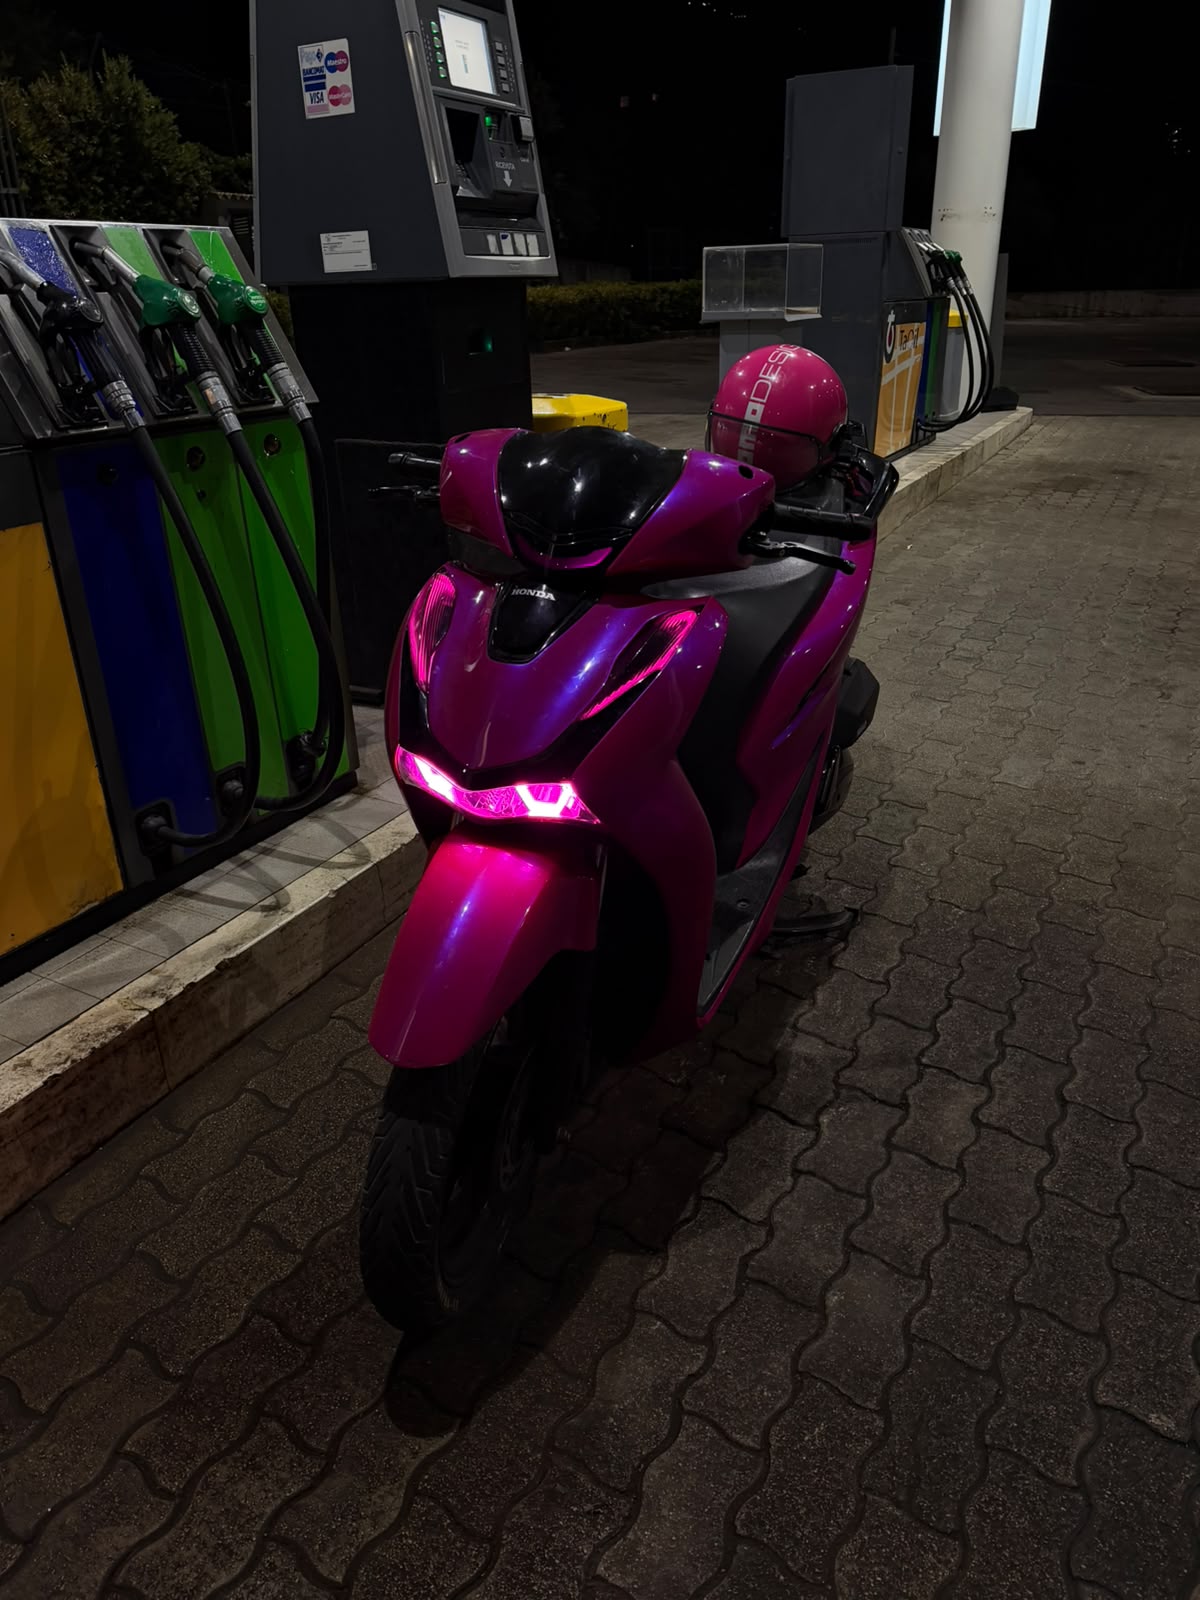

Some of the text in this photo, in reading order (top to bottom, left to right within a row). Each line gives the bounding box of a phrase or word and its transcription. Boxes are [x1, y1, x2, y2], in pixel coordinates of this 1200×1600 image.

[327, 58, 347, 66] Maestro
[309, 91, 325, 104] VISA
[511, 588, 556, 601] HONDA
